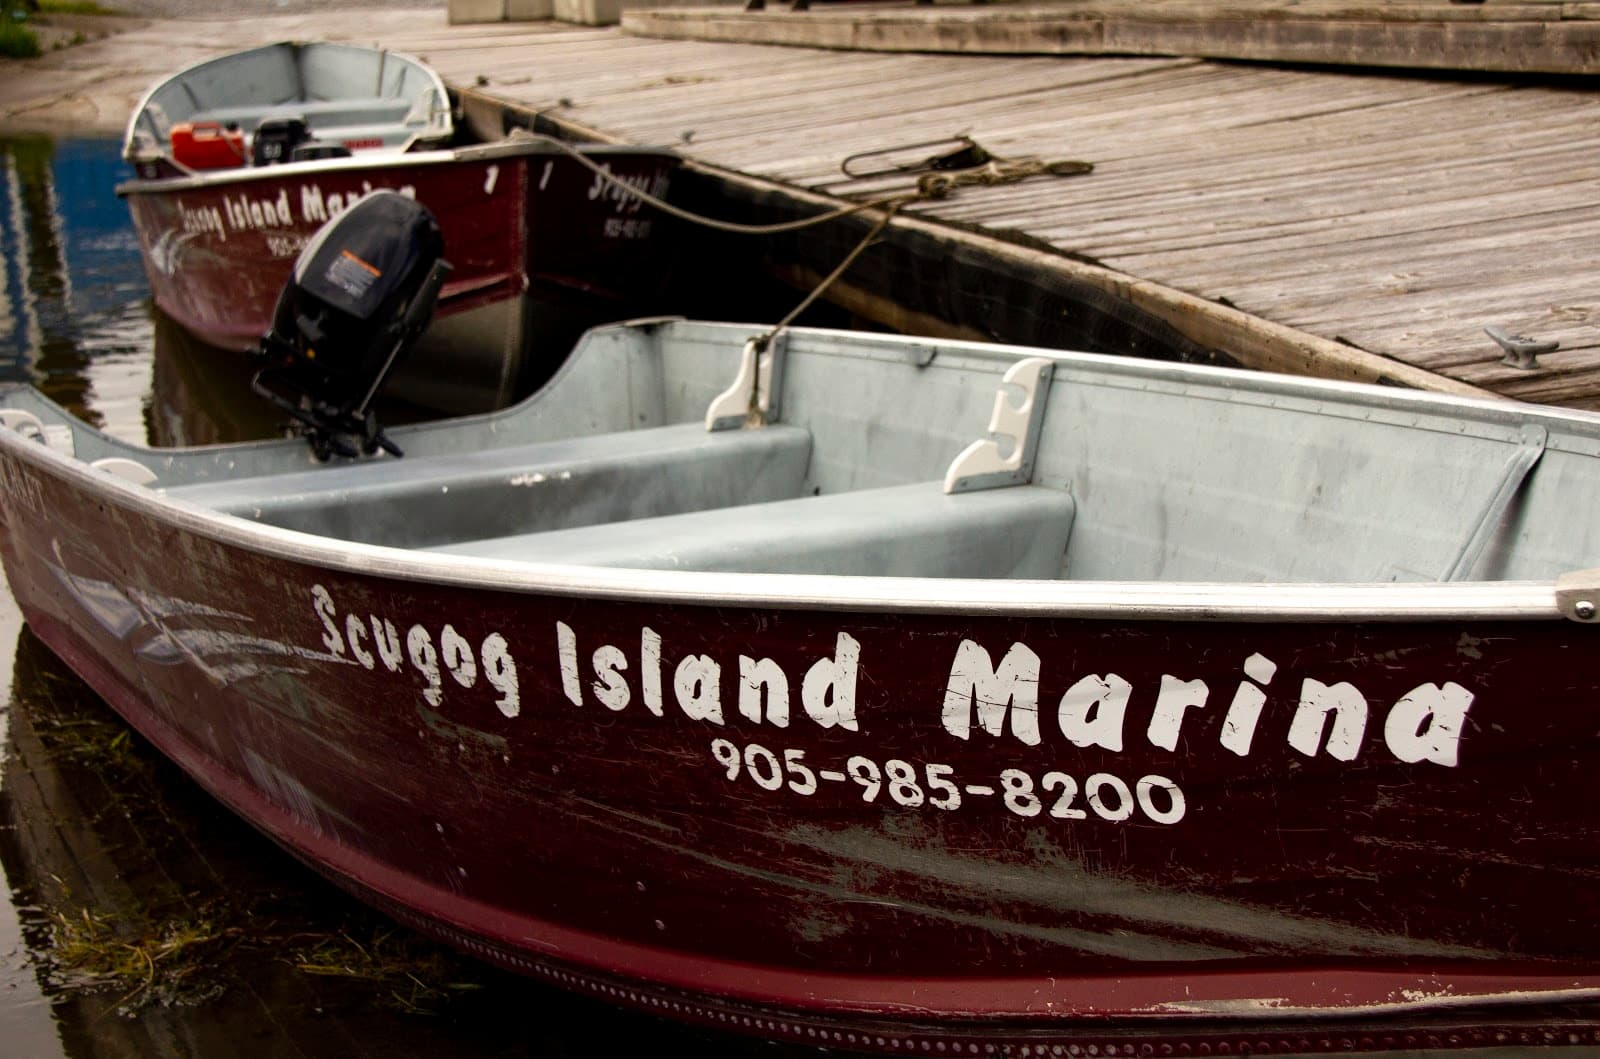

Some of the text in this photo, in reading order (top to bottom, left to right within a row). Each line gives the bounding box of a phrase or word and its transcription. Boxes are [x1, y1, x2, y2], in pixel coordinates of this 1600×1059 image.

[223, 188, 293, 230] Island
[310, 583, 1476, 768] Scugog Island Marina
[711, 738, 1187, 825] 905-985-8200
